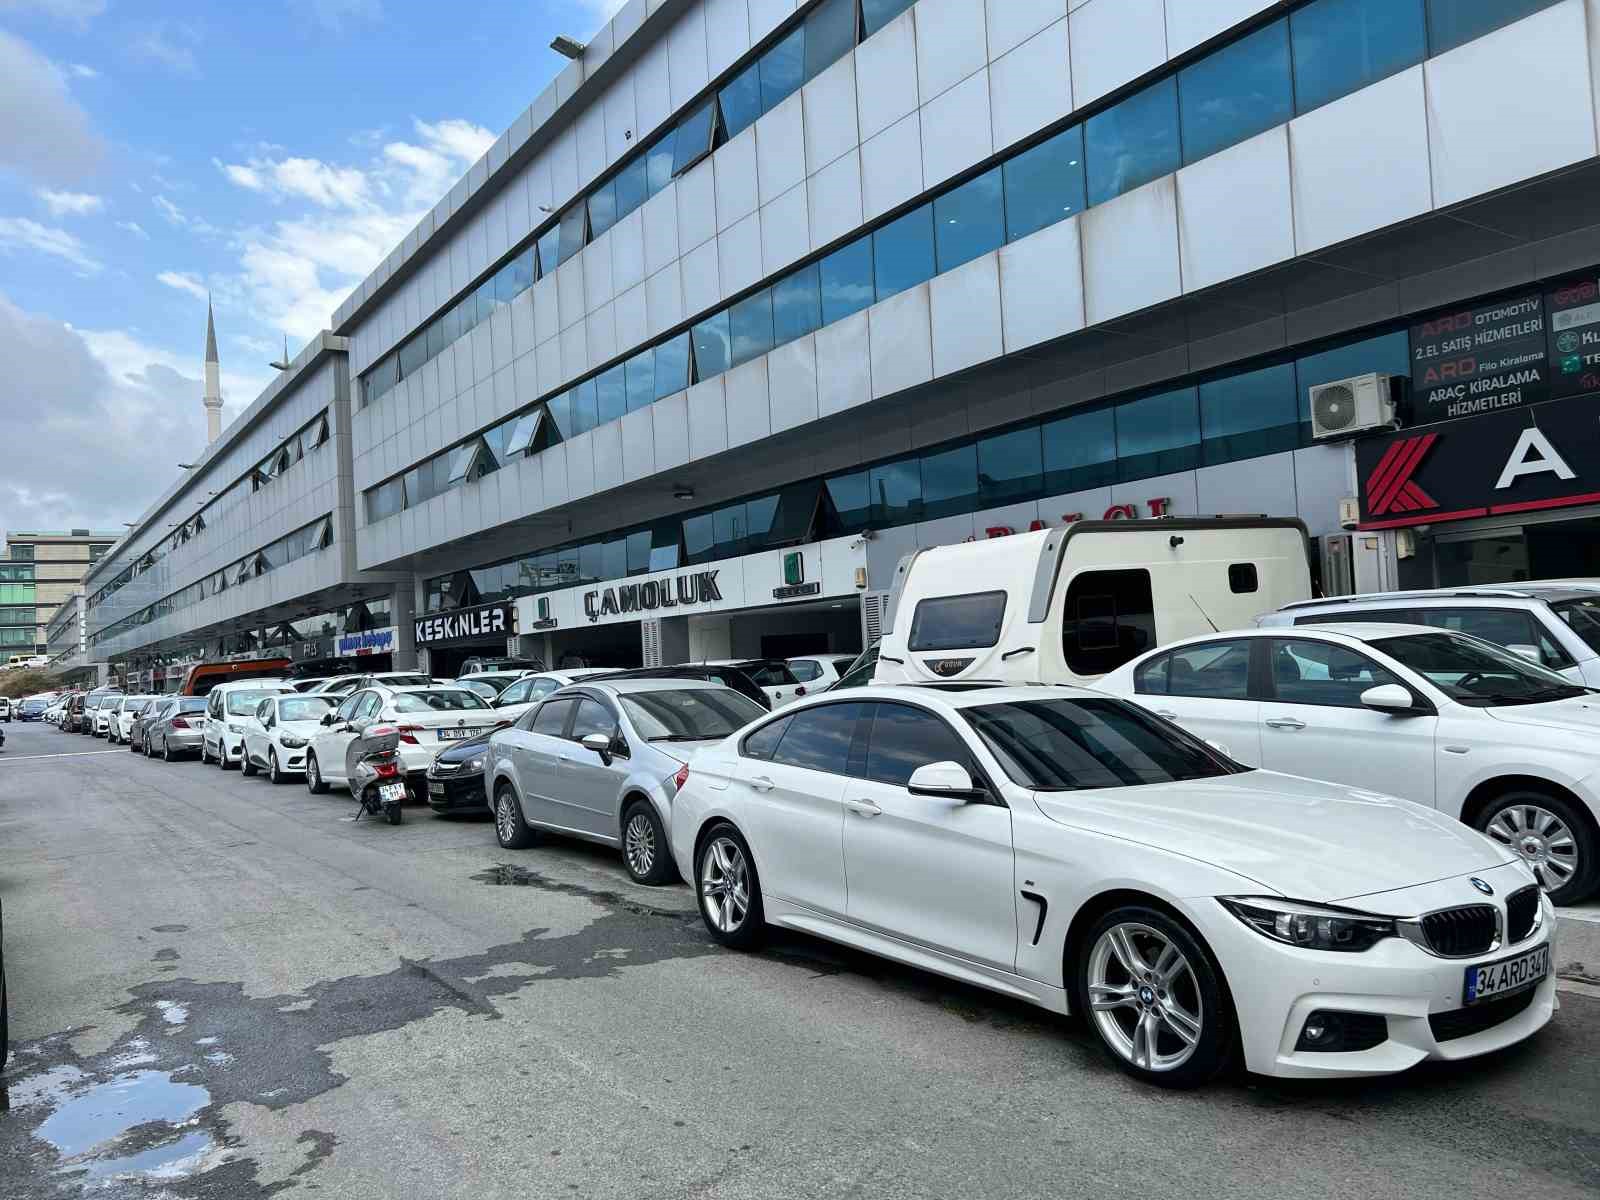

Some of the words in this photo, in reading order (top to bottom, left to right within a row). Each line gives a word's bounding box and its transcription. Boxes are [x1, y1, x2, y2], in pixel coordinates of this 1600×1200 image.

[1475, 299, 1539, 325] OTOMOTİV
[1416, 344, 1439, 361] 2.EL
[1442, 336, 1472, 352] SATIŞ
[1475, 315, 1543, 345] HİZMETLERİ
[1424, 357, 1476, 385] ARD
[1480, 361, 1497, 373] Filo
[1500, 351, 1545, 368] Kiralama
[1428, 385, 1466, 404] ARAÇ
[1470, 369, 1541, 395] KİRALAMA
[1447, 388, 1522, 417] HİZMETLERİ
[583, 569, 723, 623] ÇAMOLUK
[1478, 967, 1495, 995] 34
[1498, 957, 1528, 991] ARD
[1528, 950, 1546, 979] 341
